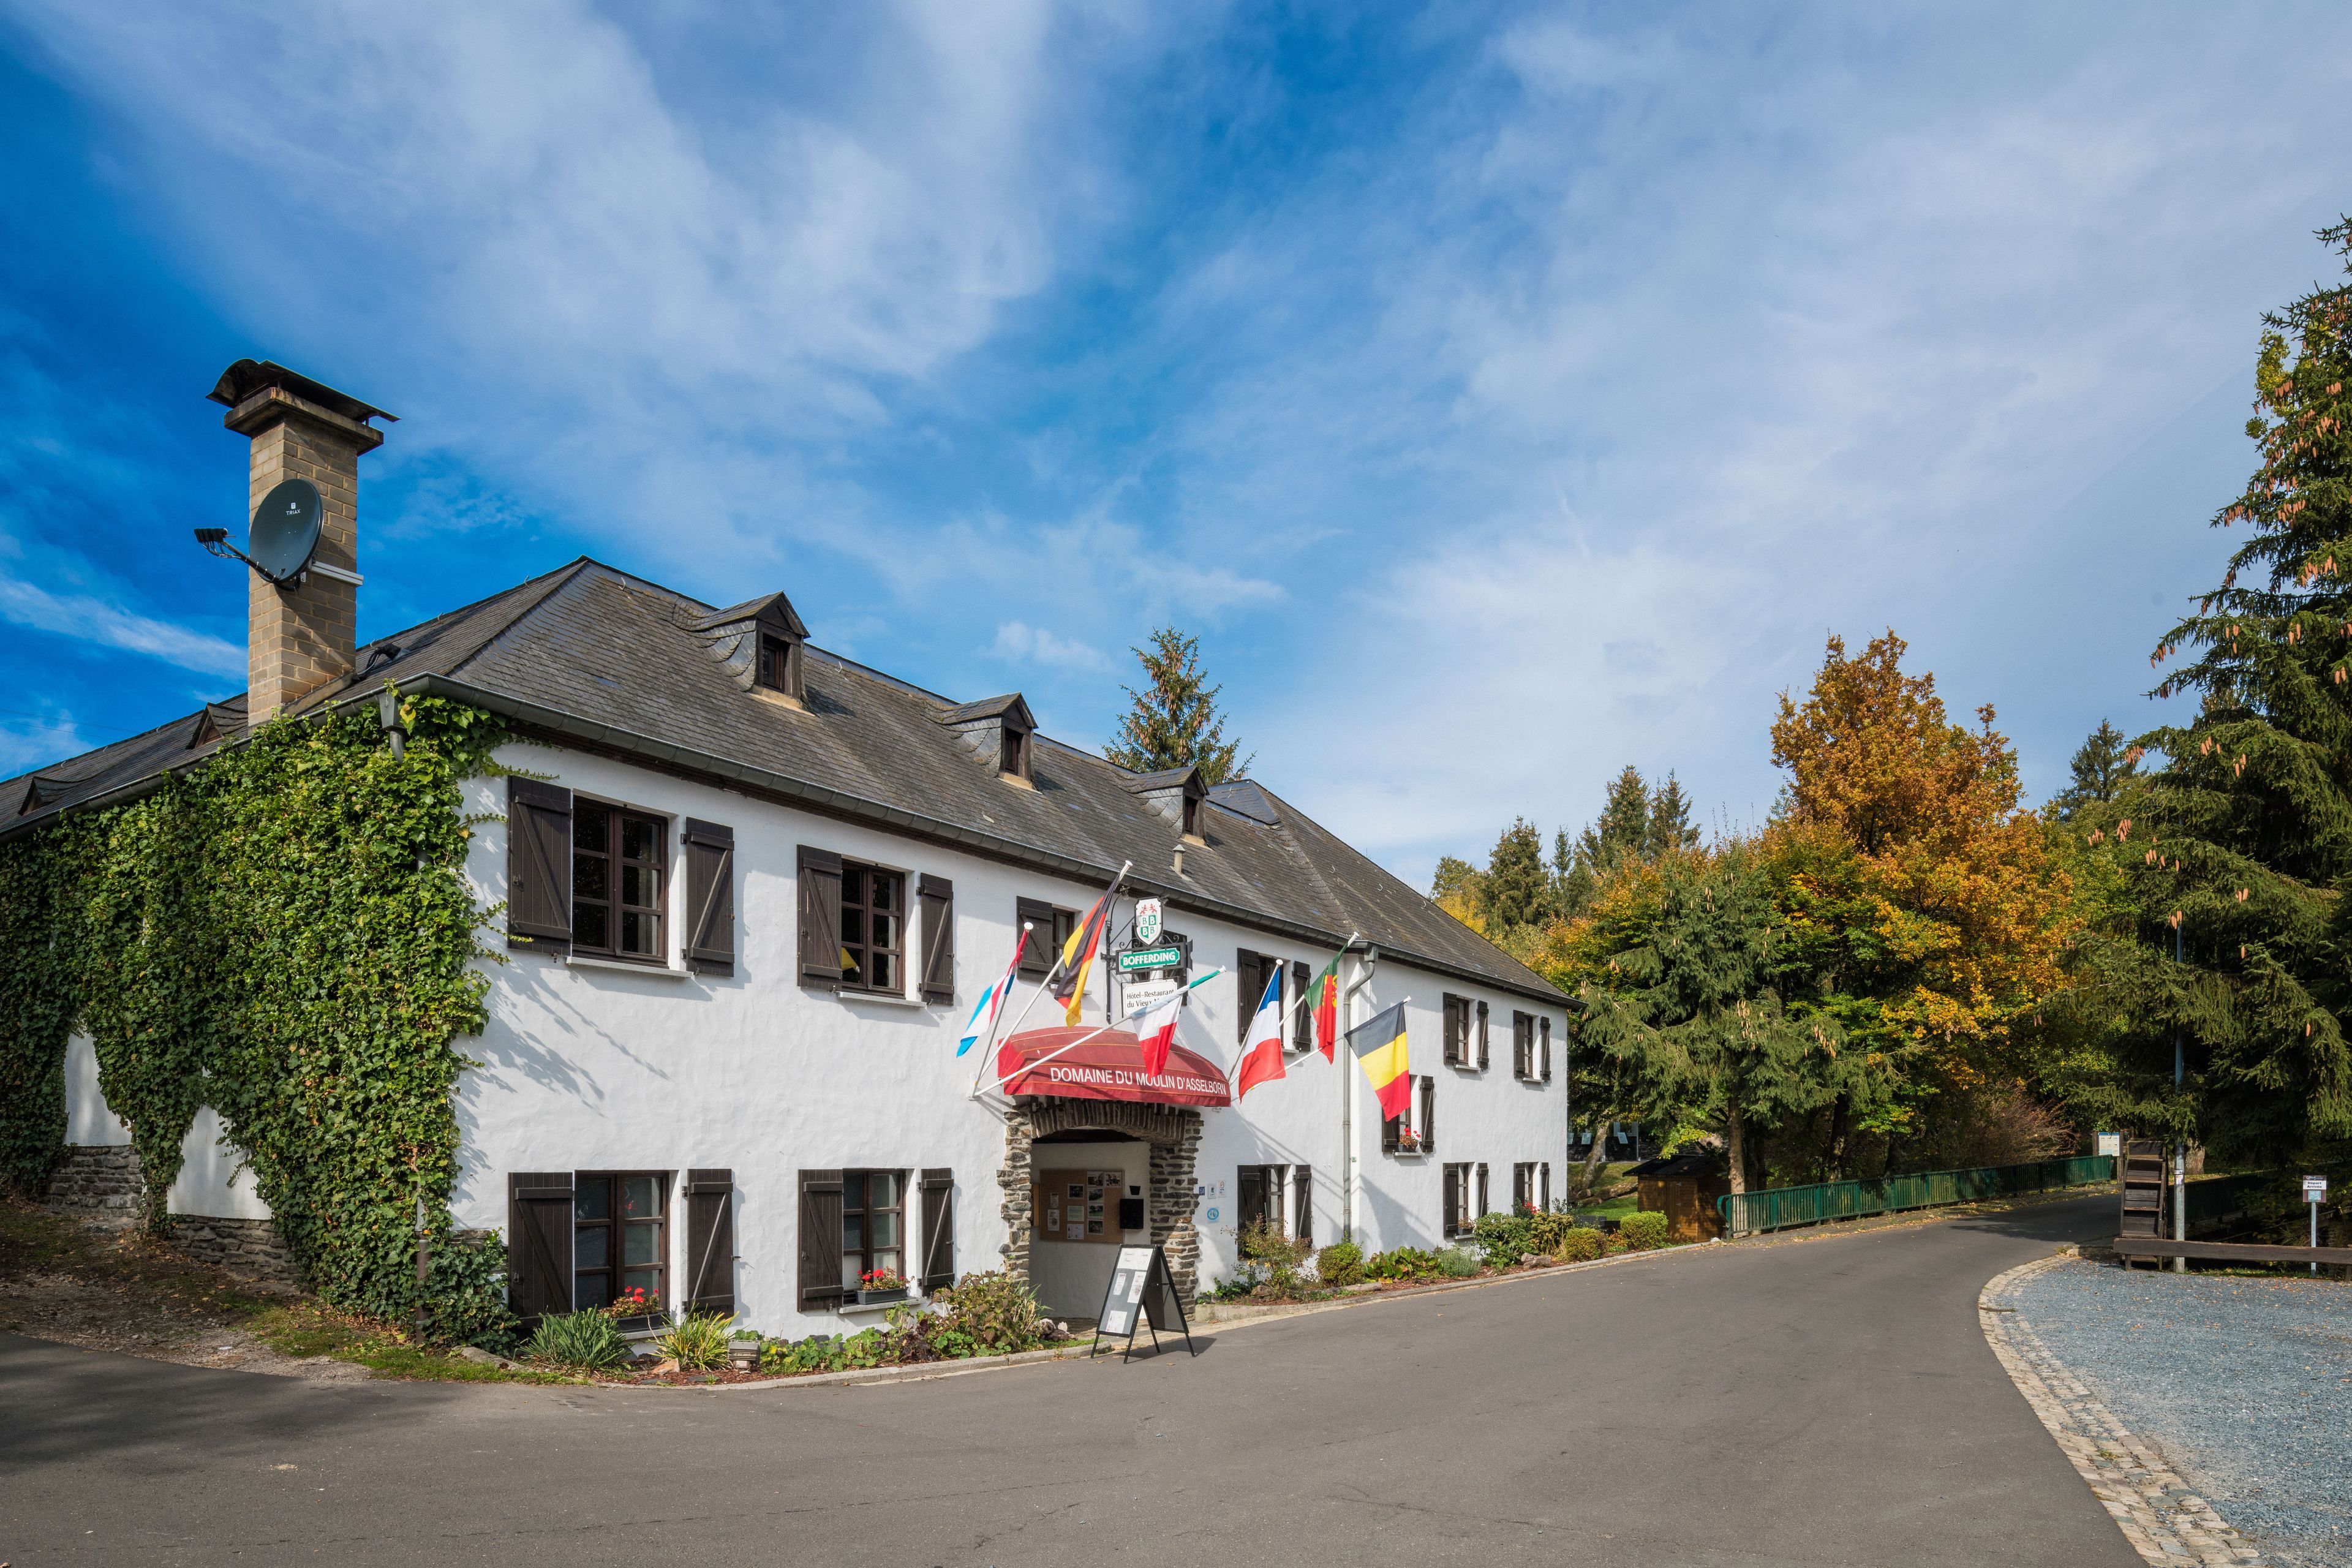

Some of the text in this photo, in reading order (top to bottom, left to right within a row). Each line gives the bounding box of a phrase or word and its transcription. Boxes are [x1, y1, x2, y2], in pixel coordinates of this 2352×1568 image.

[1123, 951, 1176, 966] BOFFERDING
[1050, 1067, 1226, 1095] DOMAINE DU MOULIN D'ASSELBORN
